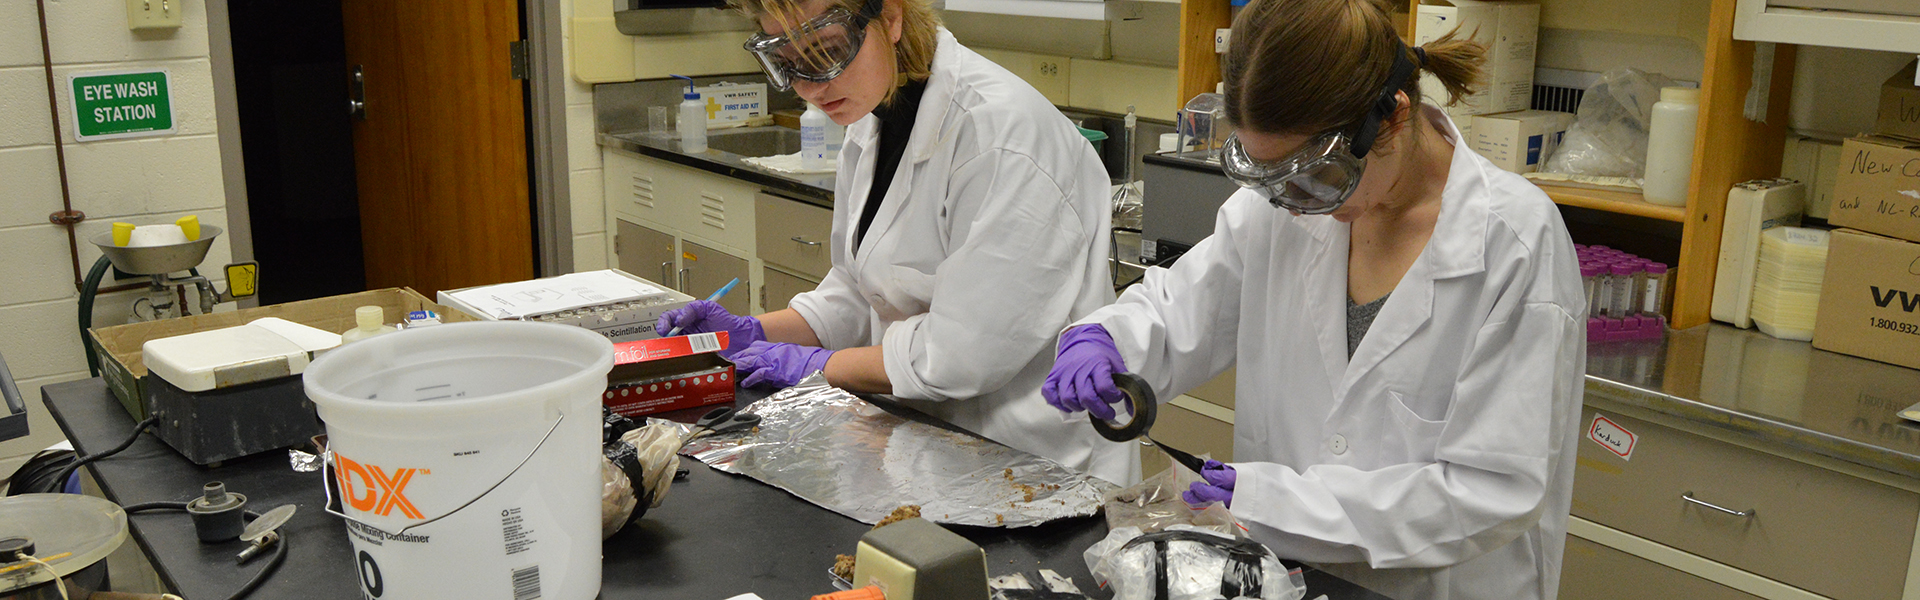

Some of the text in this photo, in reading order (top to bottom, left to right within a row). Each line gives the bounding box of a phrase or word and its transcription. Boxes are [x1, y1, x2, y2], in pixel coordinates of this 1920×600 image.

[83, 81, 158, 101] EYE WASH
[94, 103, 156, 124] STATION
[724, 103, 739, 111] FIRST
[1850, 149, 1893, 175] New
[1839, 196, 1860, 210] and
[610, 324, 652, 338] Scintillation
[630, 345, 649, 360] foil
[385, 532, 430, 544] Container
